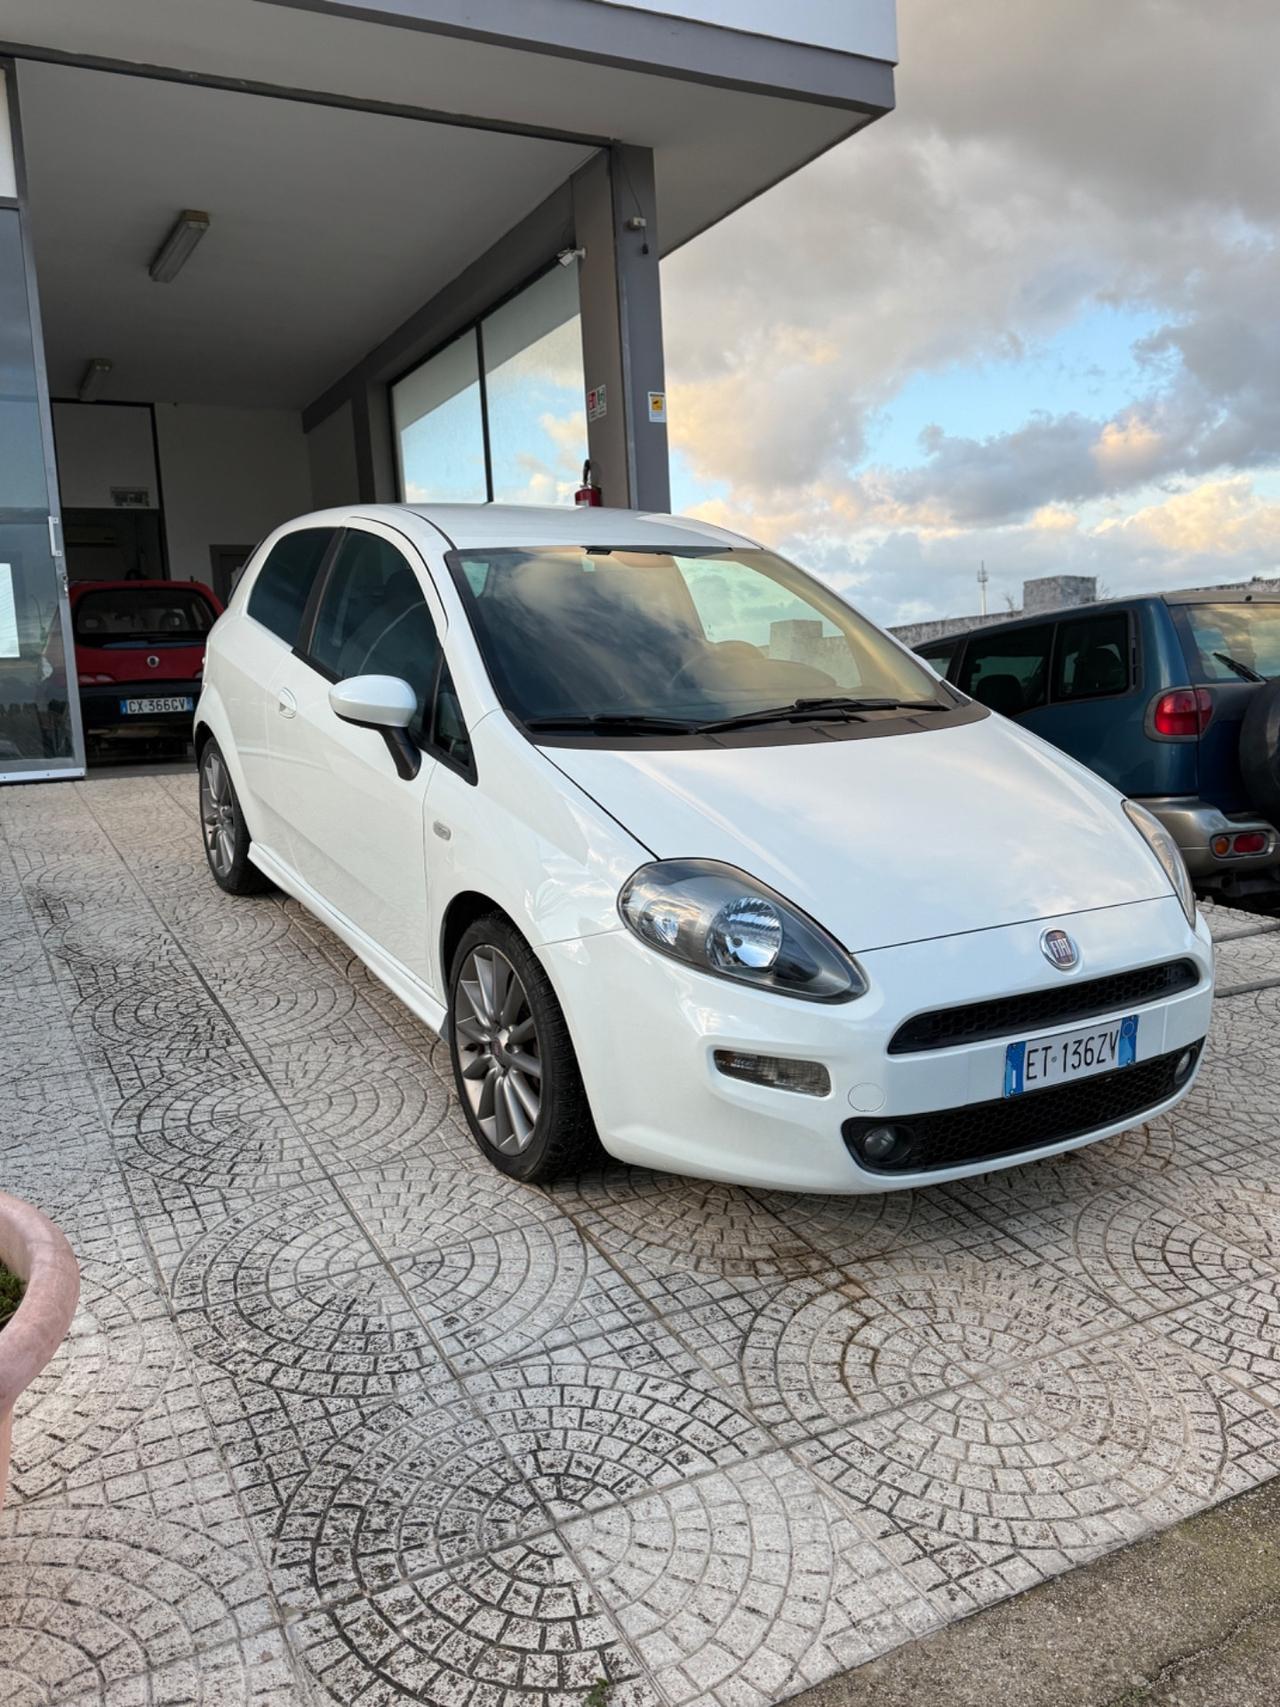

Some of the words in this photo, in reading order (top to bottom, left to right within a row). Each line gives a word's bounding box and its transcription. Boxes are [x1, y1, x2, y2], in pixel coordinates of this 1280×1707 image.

[128, 700, 144, 713] CX
[1050, 938, 1072, 958] FIAT
[1026, 1045, 1053, 1080] ET
[1062, 1029, 1119, 1073] 136ZV
